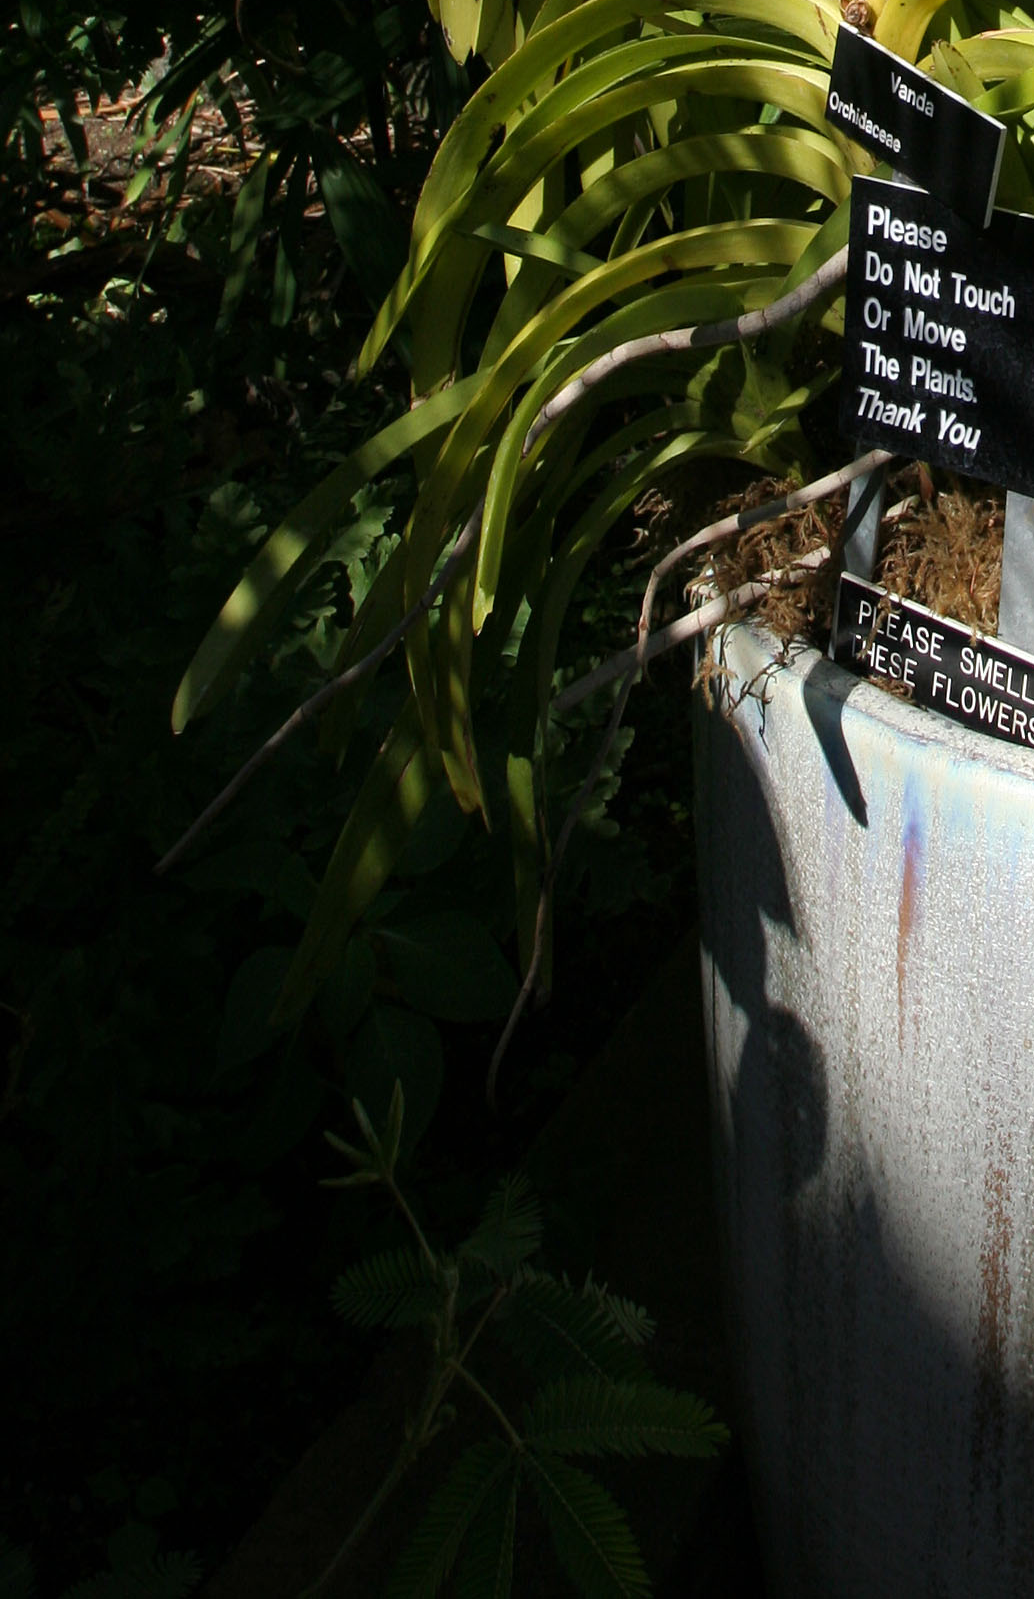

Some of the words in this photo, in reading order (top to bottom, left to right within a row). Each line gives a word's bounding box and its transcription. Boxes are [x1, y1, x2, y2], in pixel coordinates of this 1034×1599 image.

[829, 91, 902, 153] Orchidaceae
[890, 72, 935, 118] Vanda
[867, 204, 948, 253] Please
[865, 251, 893, 286] Do
[903, 260, 941, 299] Not
[951, 272, 1015, 318] Touch
[863, 297, 891, 331] Or
[903, 307, 967, 352] Move
[861, 341, 900, 381] The
[911, 355, 977, 404] Plants.
[858, 386, 926, 434] Thank
[937, 409, 981, 451] You
[858, 600, 945, 661] PLEASE
